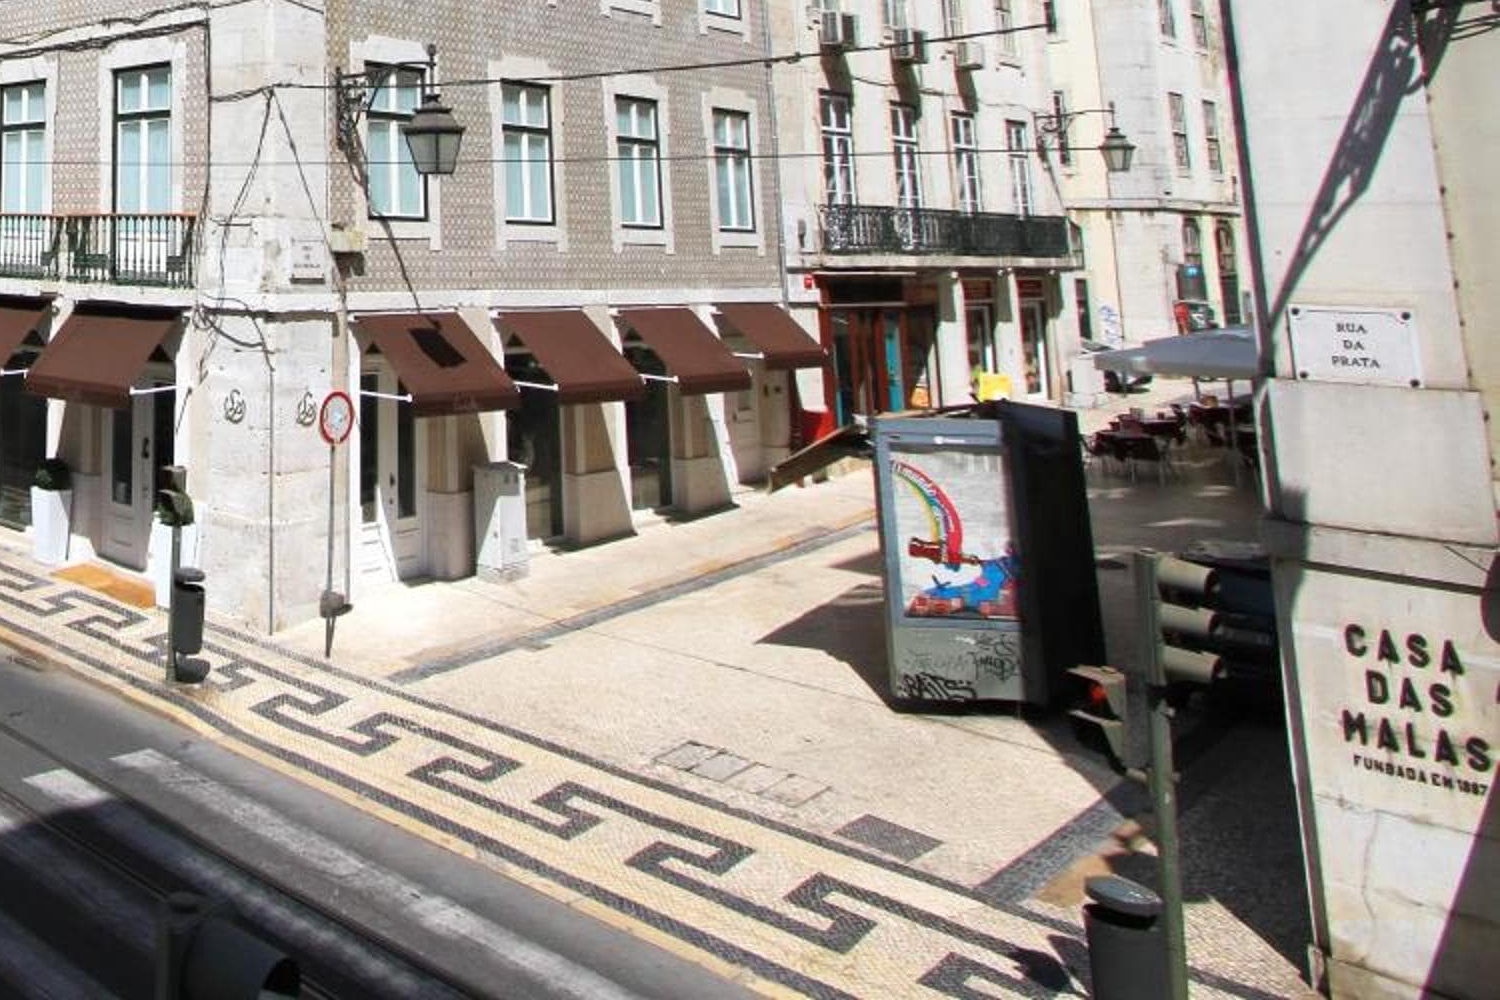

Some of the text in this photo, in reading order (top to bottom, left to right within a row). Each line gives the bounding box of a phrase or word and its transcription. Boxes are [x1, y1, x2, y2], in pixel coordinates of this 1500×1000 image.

[1336, 322, 1367, 334] RUA
[1342, 339, 1365, 350] DA
[1331, 355, 1381, 368] PRATA
[1344, 623, 1464, 676] CASA
[1365, 669, 1454, 717] DAS
[1342, 708, 1492, 773] MALAS
[1431, 773, 1454, 790] EM
